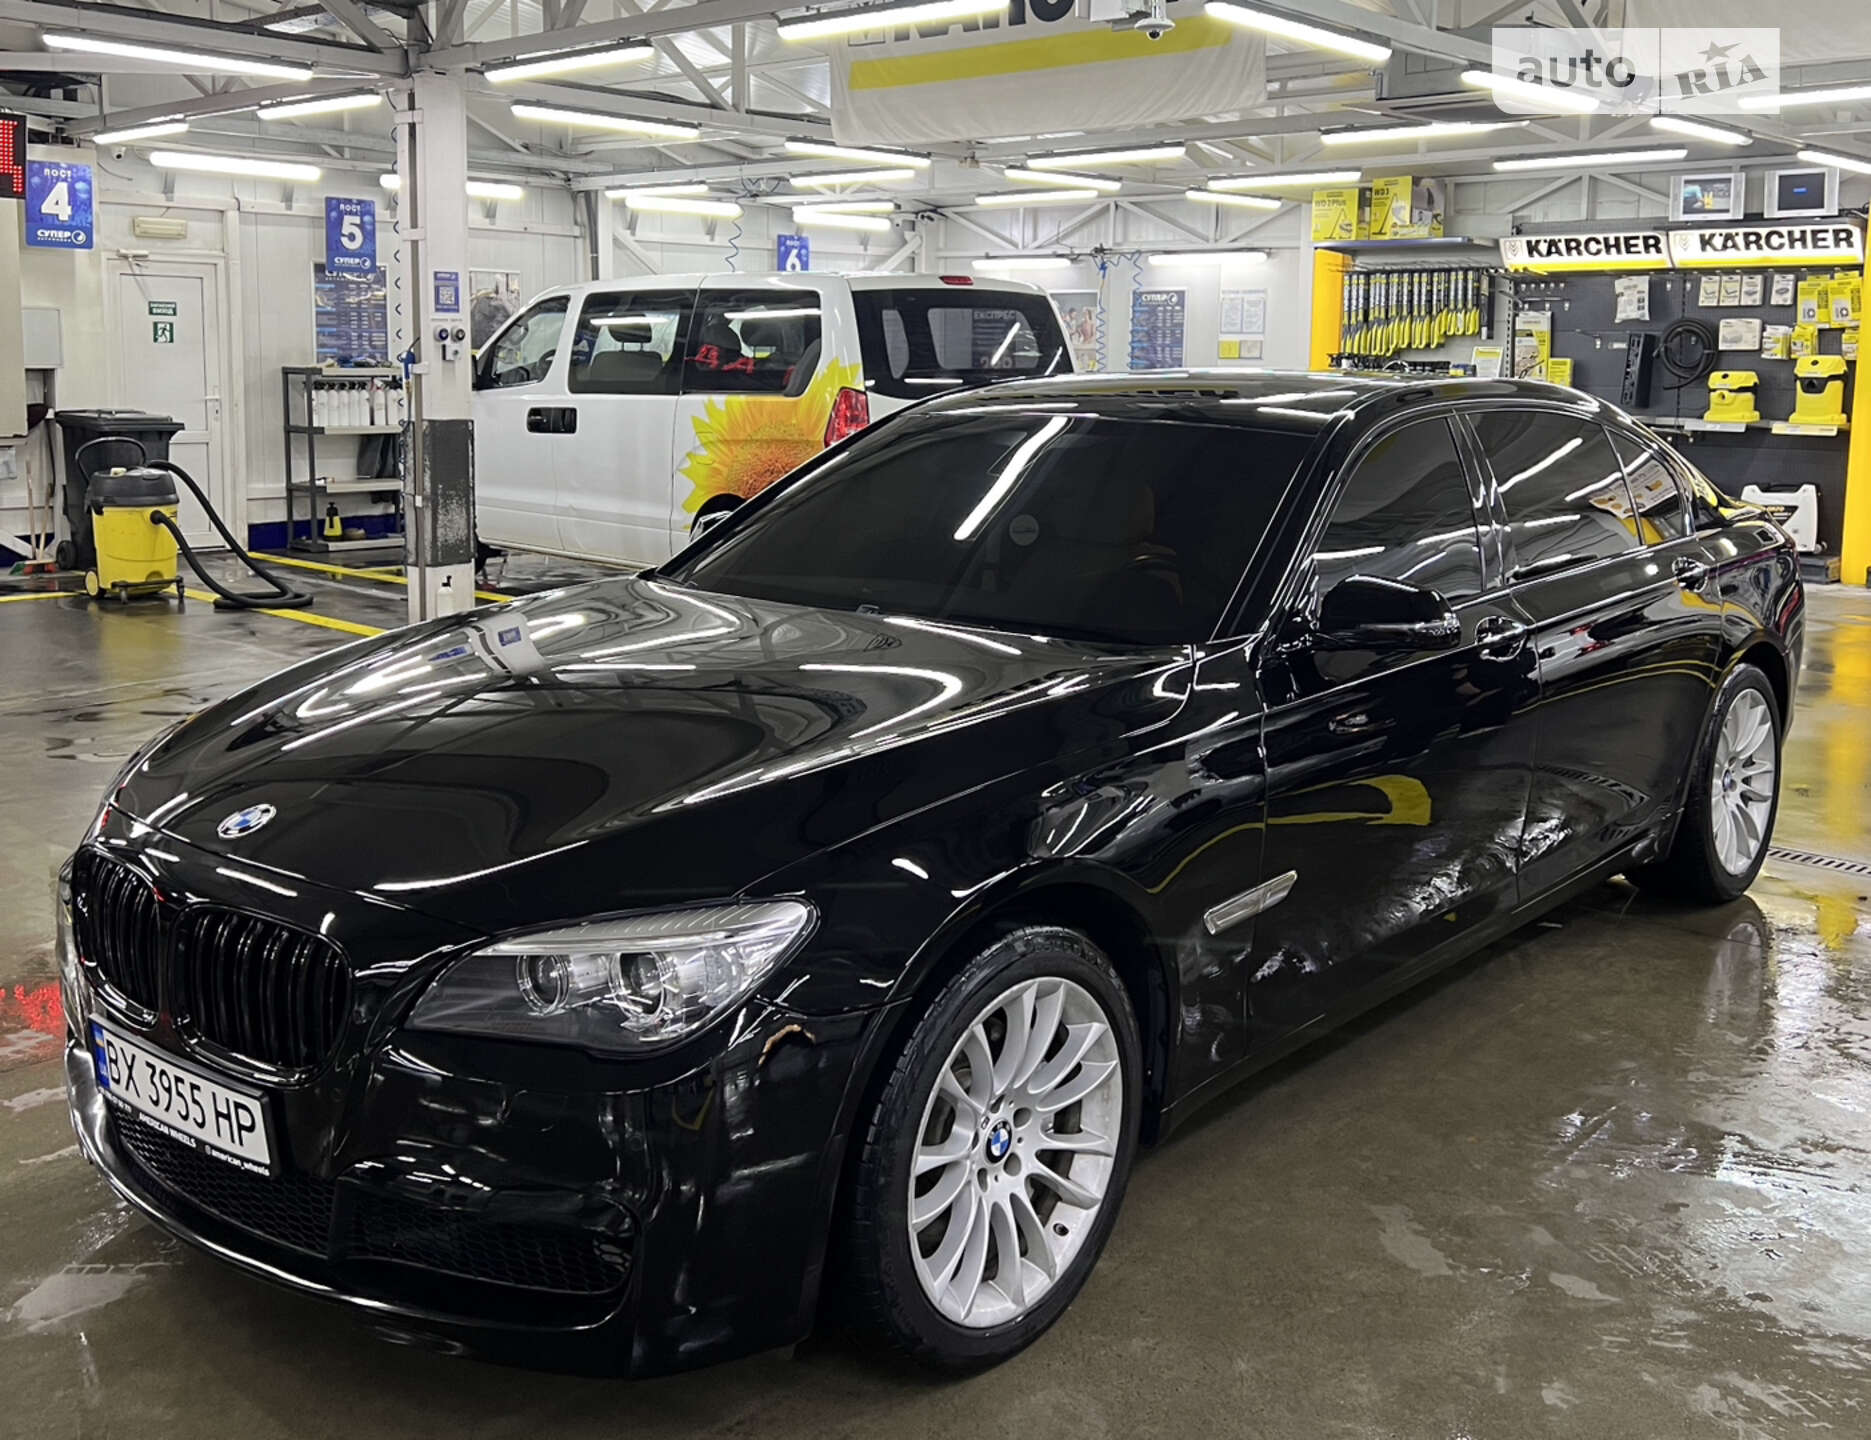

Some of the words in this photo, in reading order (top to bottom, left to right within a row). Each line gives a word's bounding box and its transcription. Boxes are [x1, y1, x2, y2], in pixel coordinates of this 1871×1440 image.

[43, 167, 72, 178] ПОСТ
[41, 181, 73, 222] 4
[339, 203, 361, 213] ПОСТ
[36, 228, 72, 240] СУПЕР
[340, 215, 364, 250] 5
[1698, 228, 1855, 252] KÄRCHER
[1525, 235, 1663, 258] KÄRCHER
[334, 256, 361, 266] СУПЕР
[785, 248, 801, 272] 6
[106, 1039, 141, 1098] BX
[145, 1060, 206, 1129] 3955
[212, 1091, 256, 1147] HP
[169, 1125, 197, 1148] WHEELS
